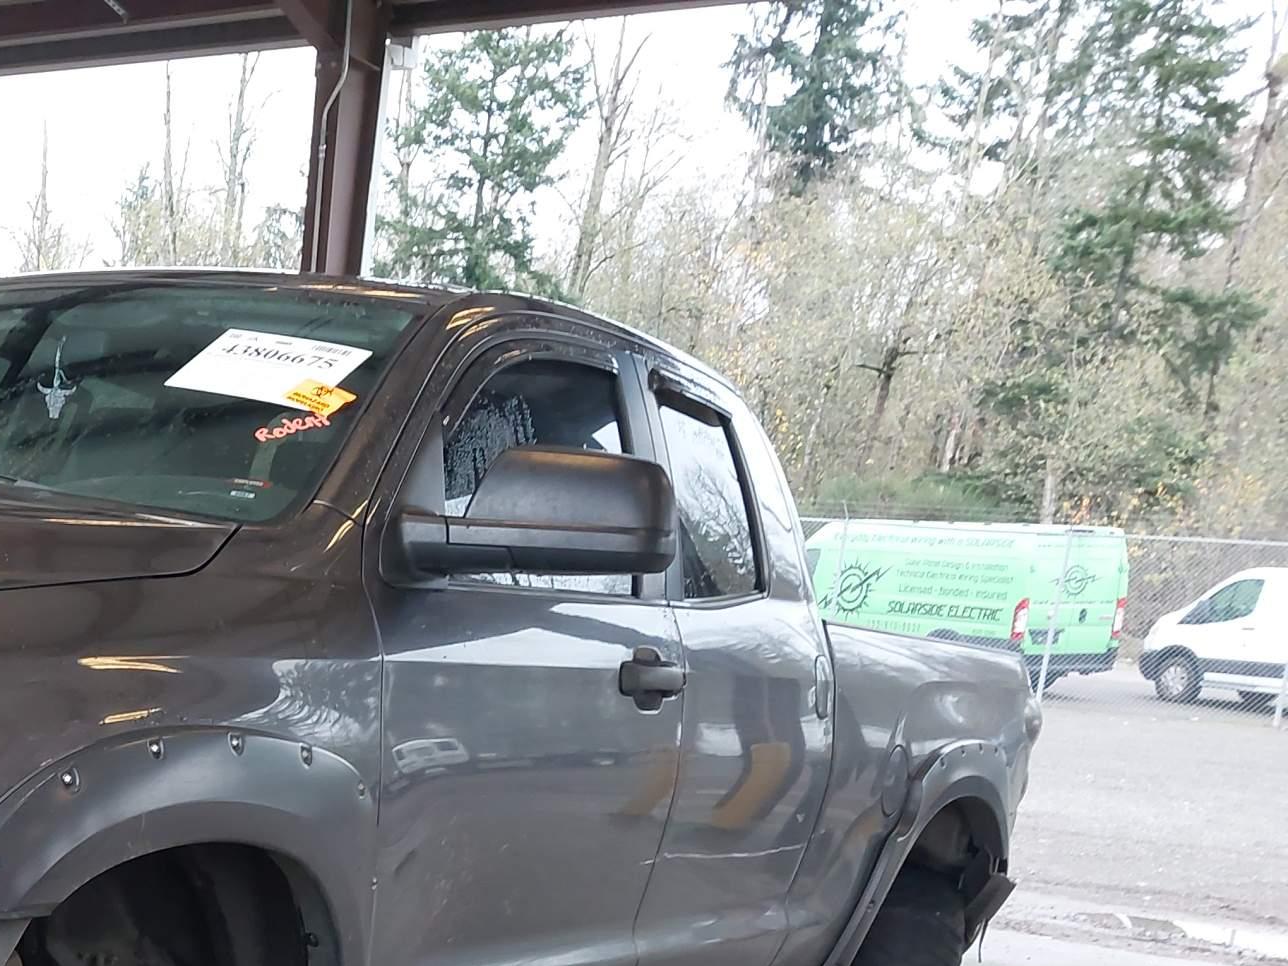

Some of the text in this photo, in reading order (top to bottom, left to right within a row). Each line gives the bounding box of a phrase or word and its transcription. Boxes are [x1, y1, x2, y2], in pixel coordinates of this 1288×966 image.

[222, 343, 339, 369] 43806675
[887, 600, 1004, 622] SOLARSIDE ELECTRIC
